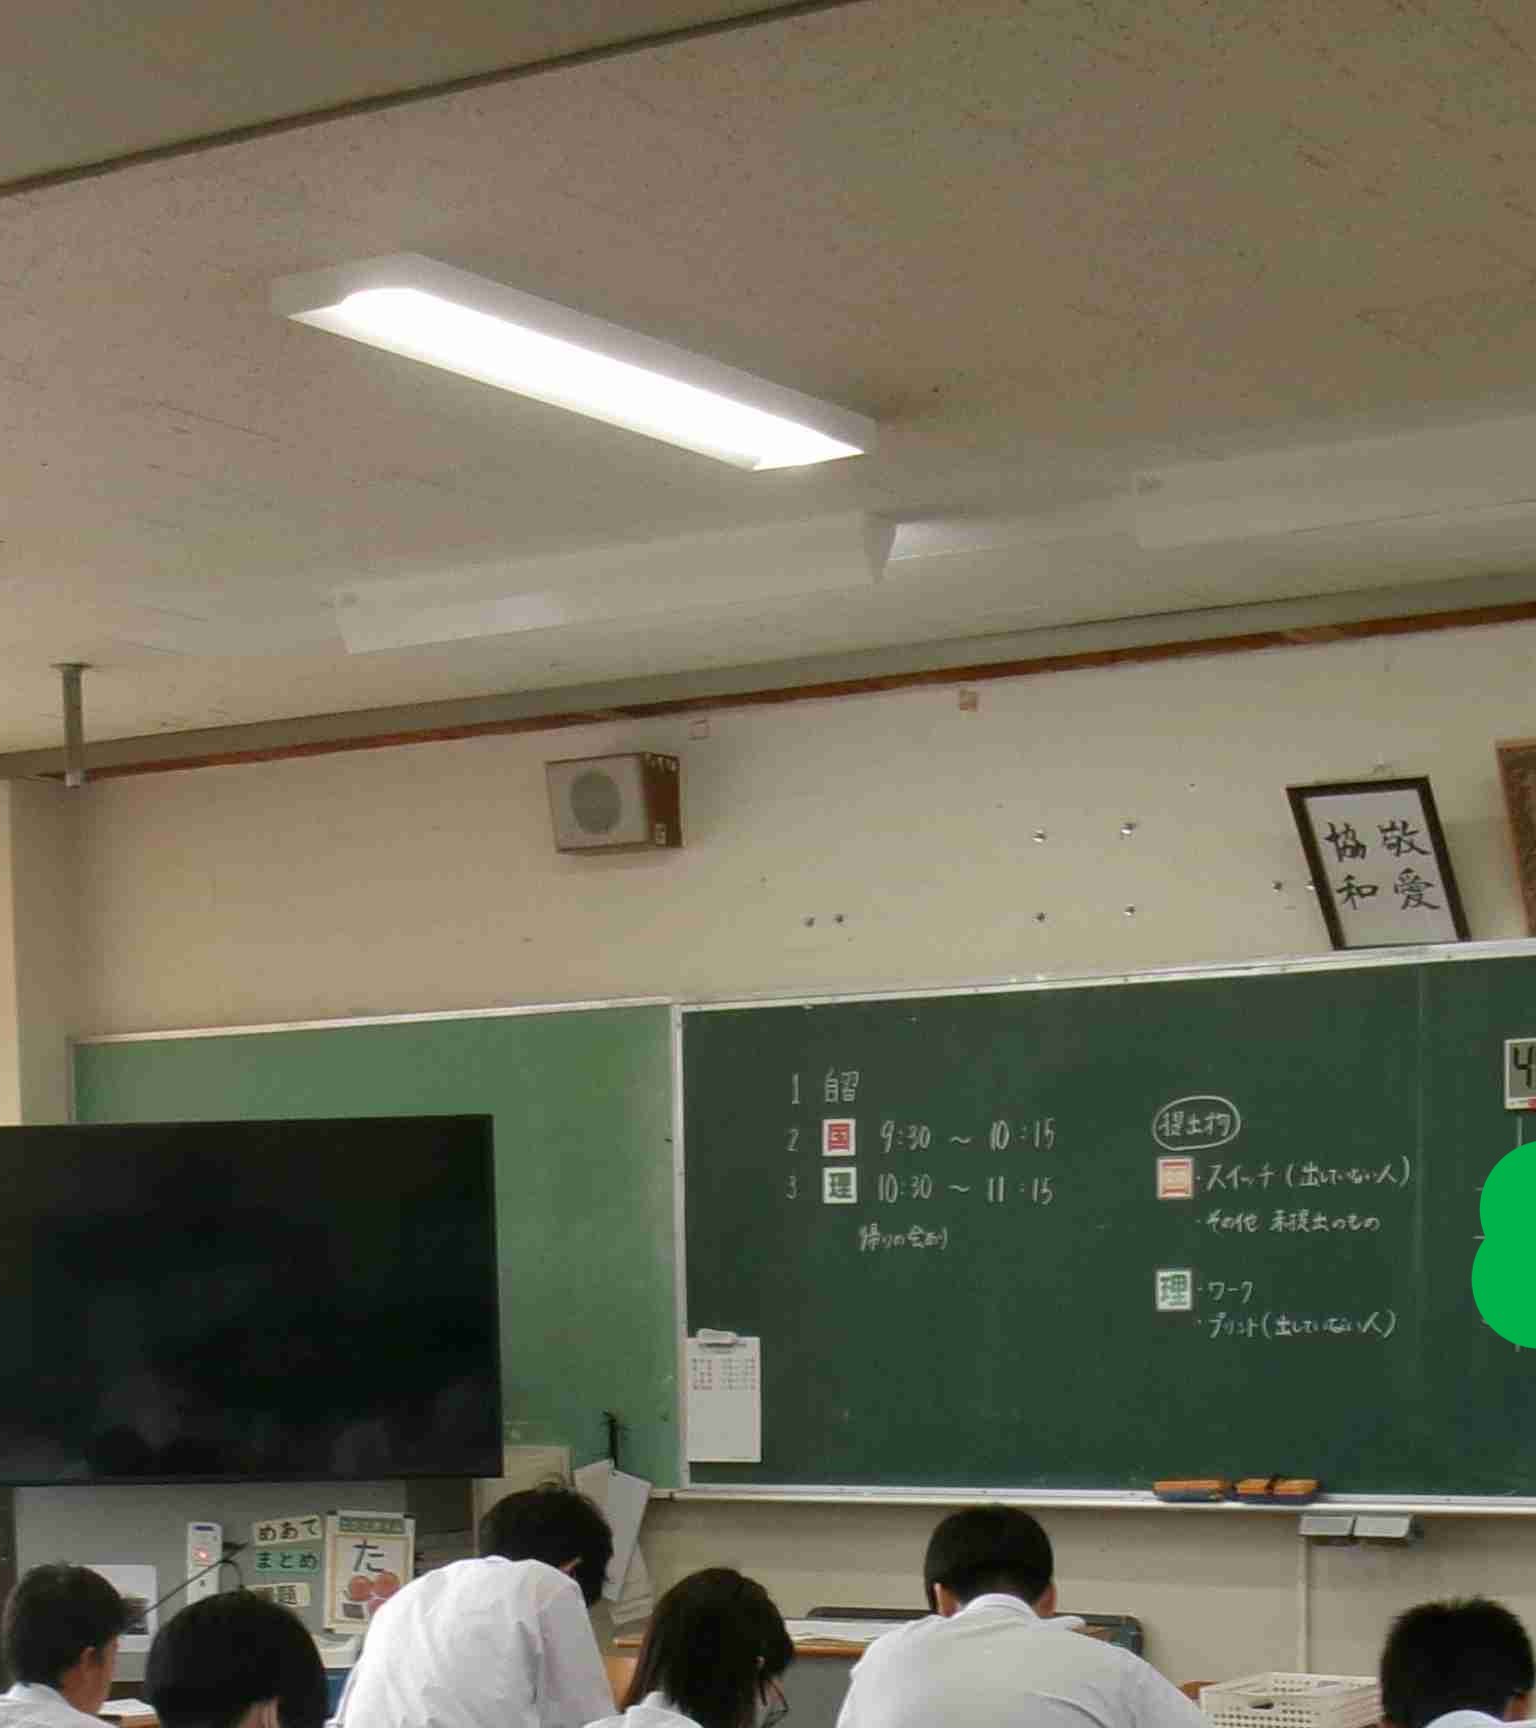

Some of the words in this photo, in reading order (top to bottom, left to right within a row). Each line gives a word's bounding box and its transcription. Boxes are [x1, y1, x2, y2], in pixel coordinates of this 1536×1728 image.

[823, 1066, 861, 1103] 自習
[880, 1118, 932, 1153] 9:30
[877, 1172, 933, 1203] 10:30
[258, 1517, 319, 1542] めあて
[257, 1551, 319, 1571] まとめ
[352, 1536, 386, 1574] た
